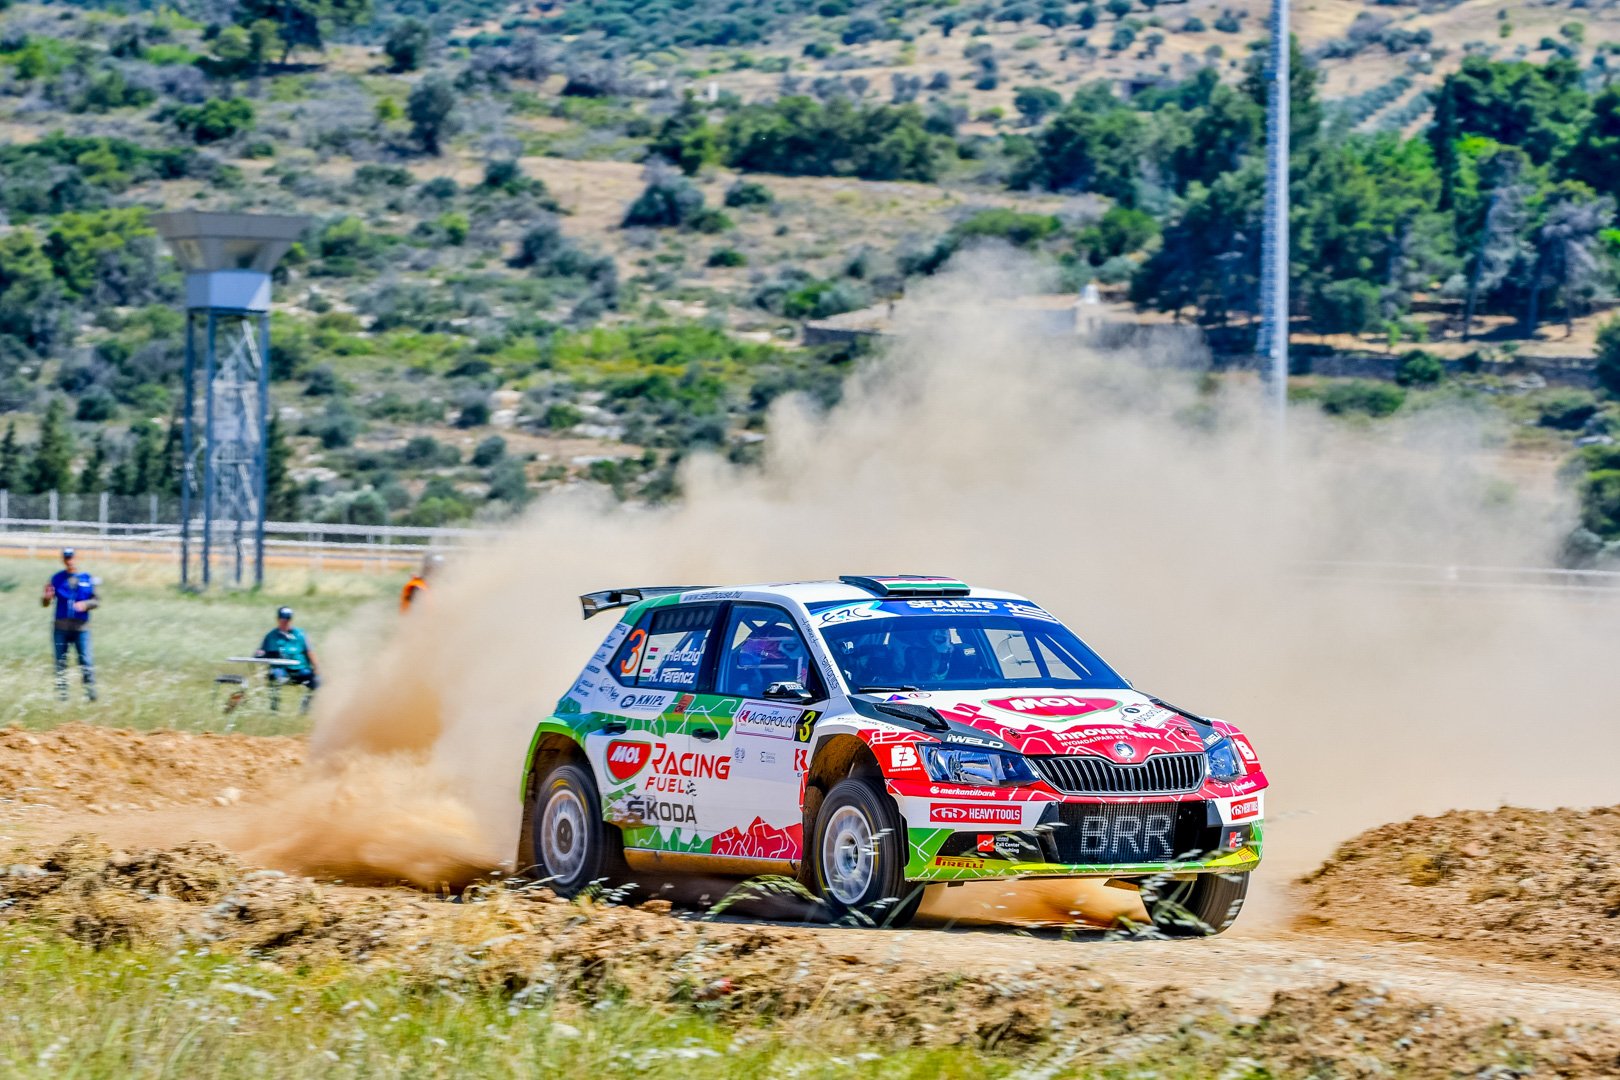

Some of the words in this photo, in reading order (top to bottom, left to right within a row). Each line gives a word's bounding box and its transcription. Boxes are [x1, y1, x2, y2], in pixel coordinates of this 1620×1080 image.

[906, 599, 998, 610] SEAJETS
[621, 628, 647, 673] 3
[635, 694, 666, 706] KNIPL
[1008, 697, 1086, 710] MOL
[747, 712, 796, 728] ACROPOLIS
[799, 710, 816, 743] 3
[1060, 735, 1115, 747] NYOMDAIPARI
[1115, 734, 1132, 742] KFT.
[610, 746, 640, 764] MOL
[652, 743, 731, 780] RACING
[645, 776, 686, 794] FUEL
[939, 787, 997, 798] merkantilbank
[626, 795, 699, 825] ŠKODA
[969, 808, 995, 819] HEAVY
[996, 809, 1020, 820] TOOLS
[935, 856, 985, 869] PIRELLI
